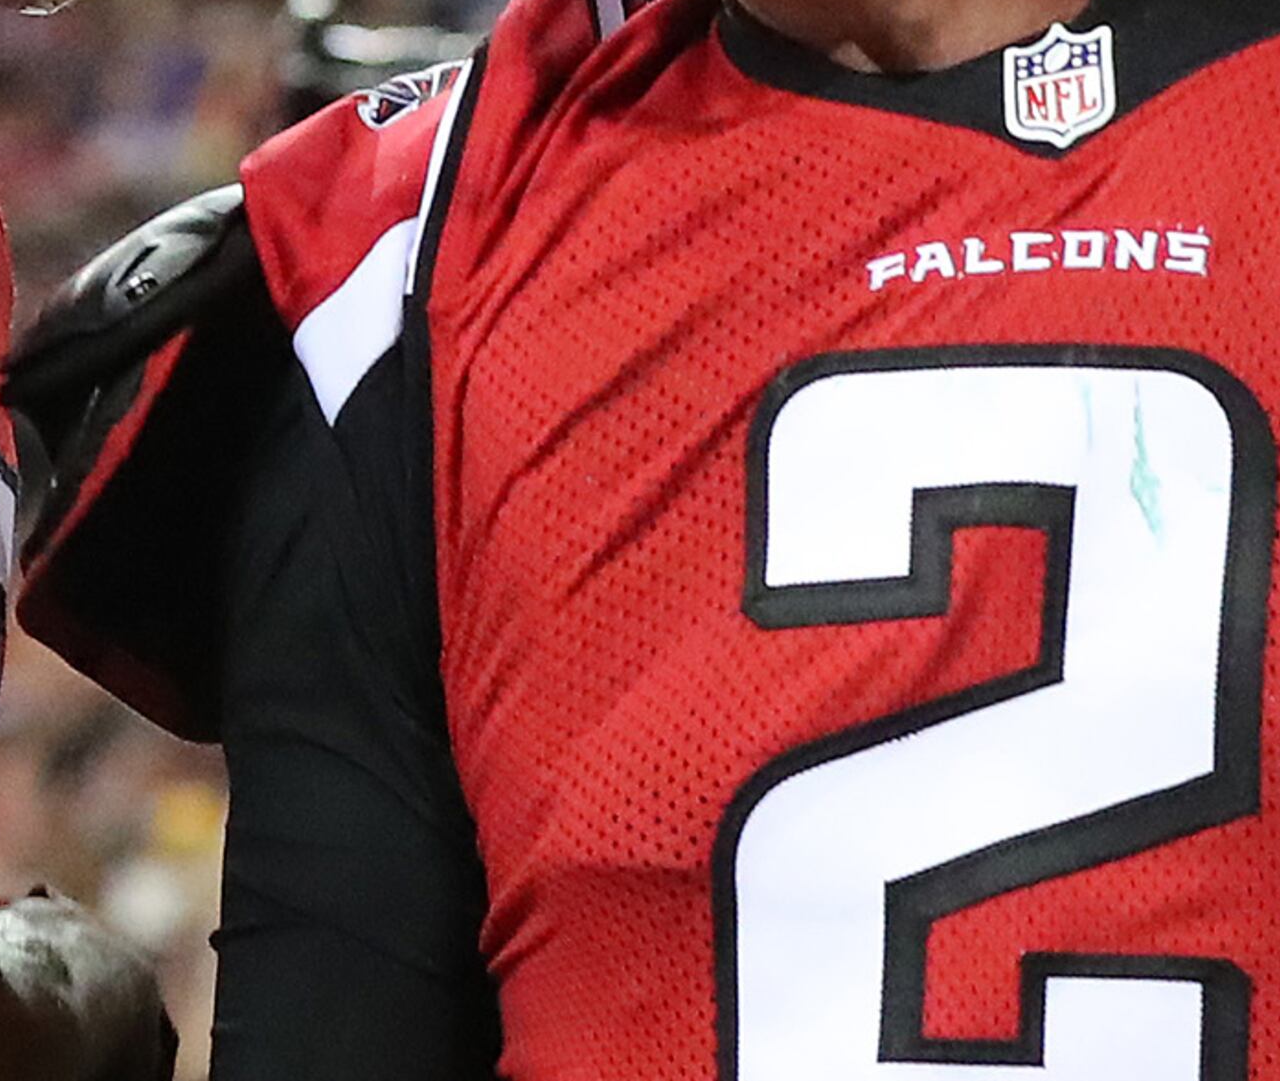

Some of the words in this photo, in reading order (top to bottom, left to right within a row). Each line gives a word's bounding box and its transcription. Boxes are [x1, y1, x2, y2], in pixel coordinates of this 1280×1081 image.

[1023, 74, 1099, 126] NFL
[865, 226, 1213, 293] FALCONS
[710, 343, 1280, 1081] 2
